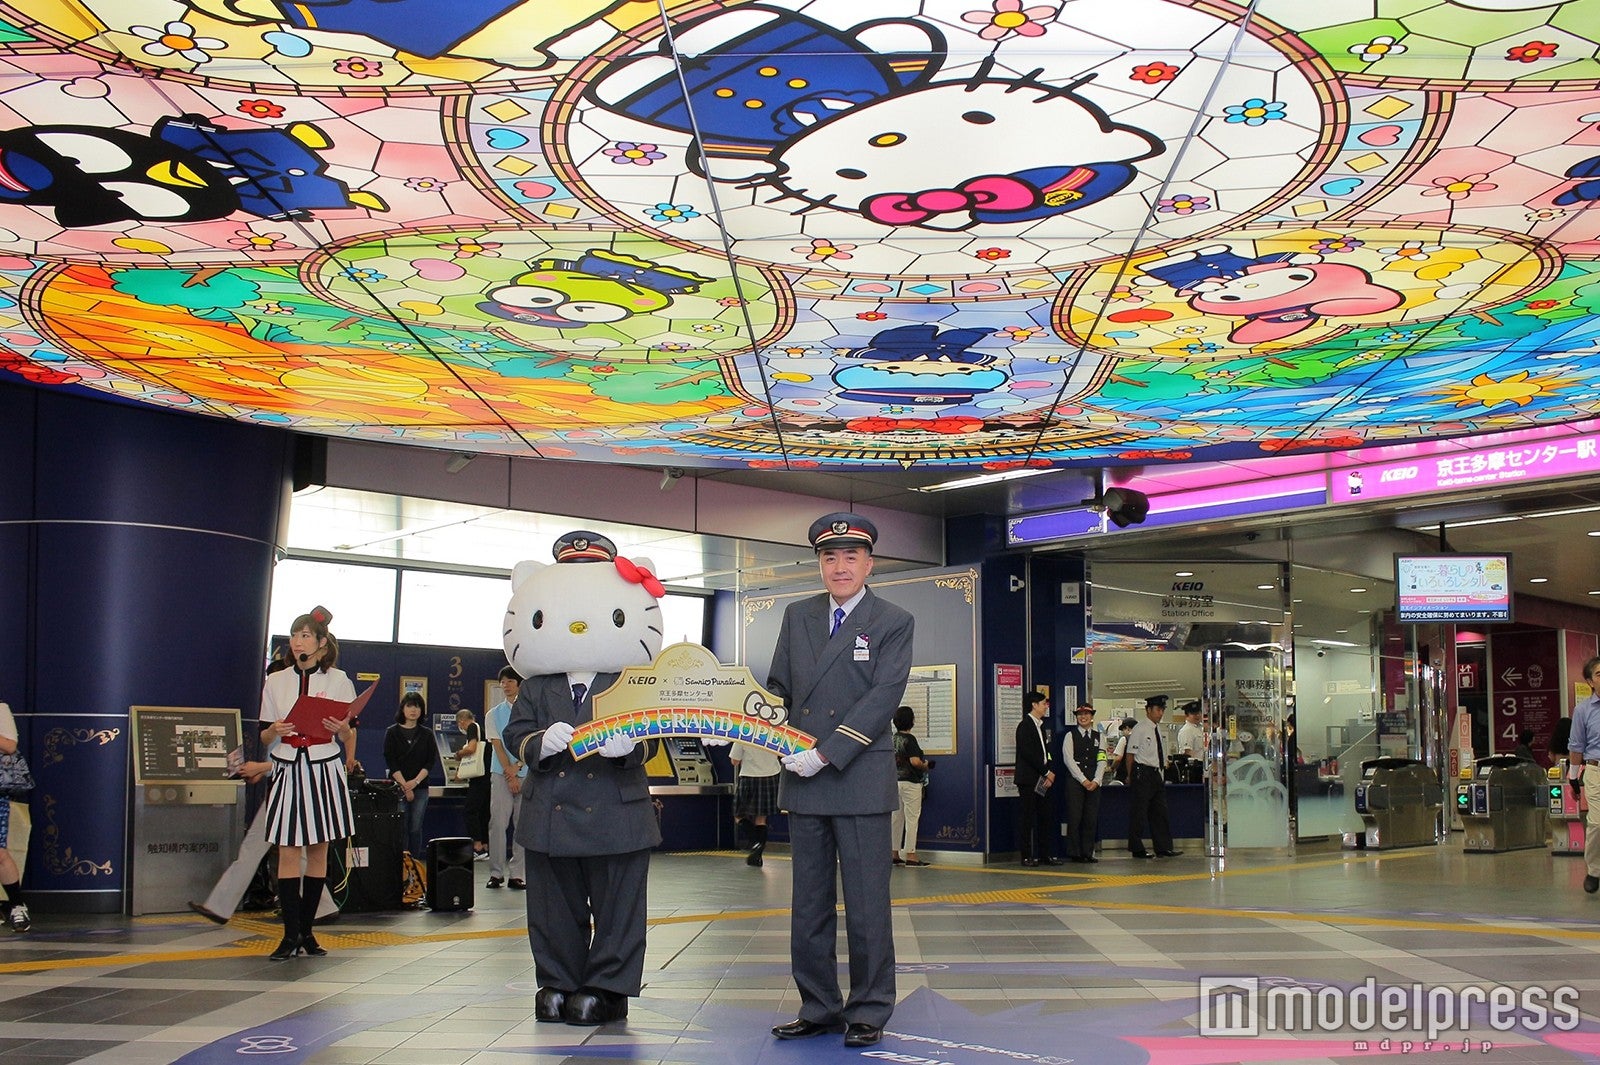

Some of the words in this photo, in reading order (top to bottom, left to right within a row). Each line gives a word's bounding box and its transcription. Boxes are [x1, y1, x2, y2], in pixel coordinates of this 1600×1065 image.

[1436, 439, 1597, 479] 京王多摩センター駅
[1380, 466, 1418, 483] KEIO
[1499, 470, 1527, 480] Station
[1172, 581, 1204, 591] KEIO
[1161, 594, 1214, 608] 駅事務室
[1161, 609, 1190, 618] Station
[1191, 609, 1215, 618] Office
[449, 656, 463, 678] 3
[627, 676, 657, 685] KEIO
[685, 677, 711, 686] Sanrio
[659, 690, 714, 698] 京王多摩センター駅
[1502, 697, 1517, 716] 3
[656, 713, 734, 732] GRAND
[738, 719, 799, 753] OPEN
[1502, 723, 1519, 742] 4
